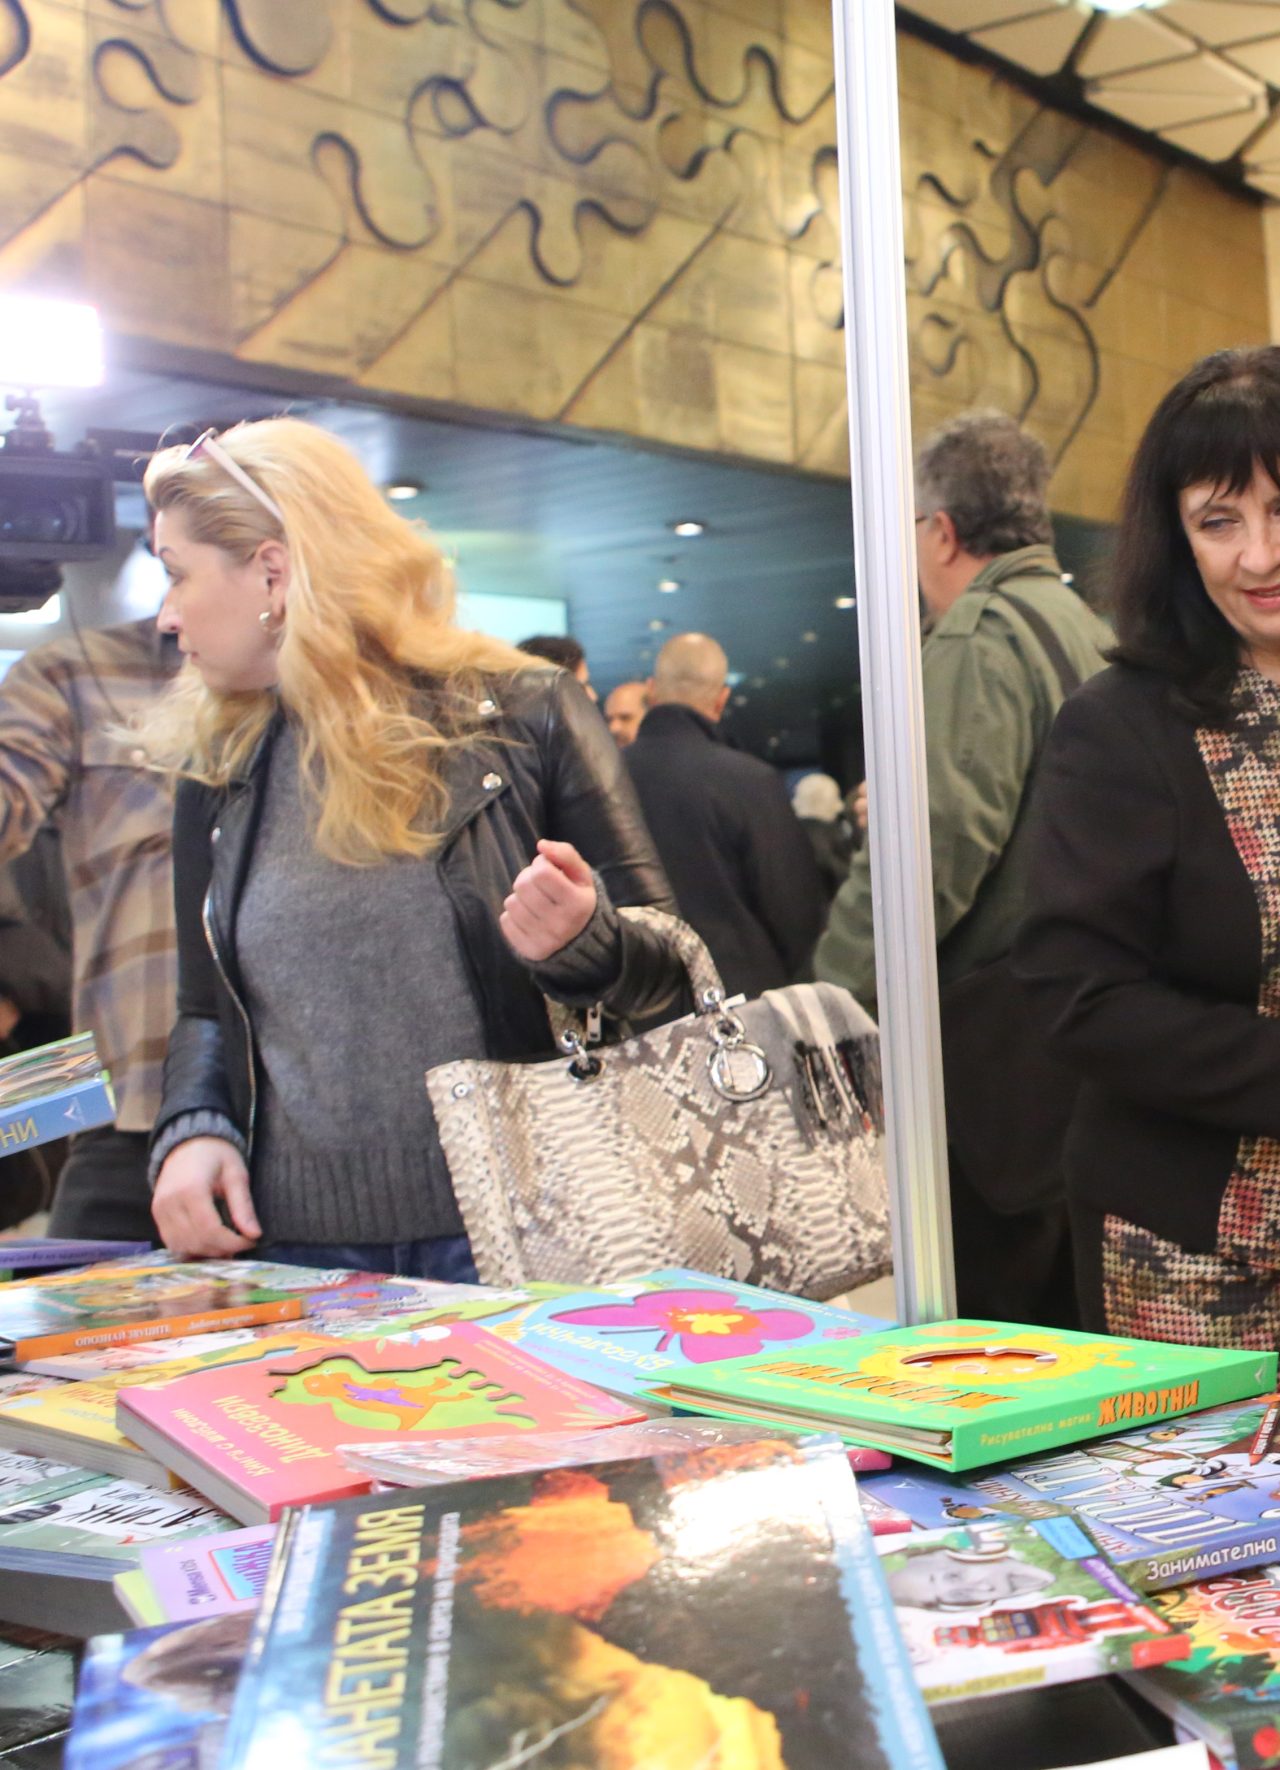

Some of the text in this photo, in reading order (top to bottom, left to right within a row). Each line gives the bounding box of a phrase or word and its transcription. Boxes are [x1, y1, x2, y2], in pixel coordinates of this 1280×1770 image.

[211, 1395, 333, 1464] Динозаври
[1096, 1379, 1200, 1427] ЖИВОТНИ
[342, 1503, 426, 1597] ЗЕМЯ
[1145, 1533, 1278, 1582] Занимателна
